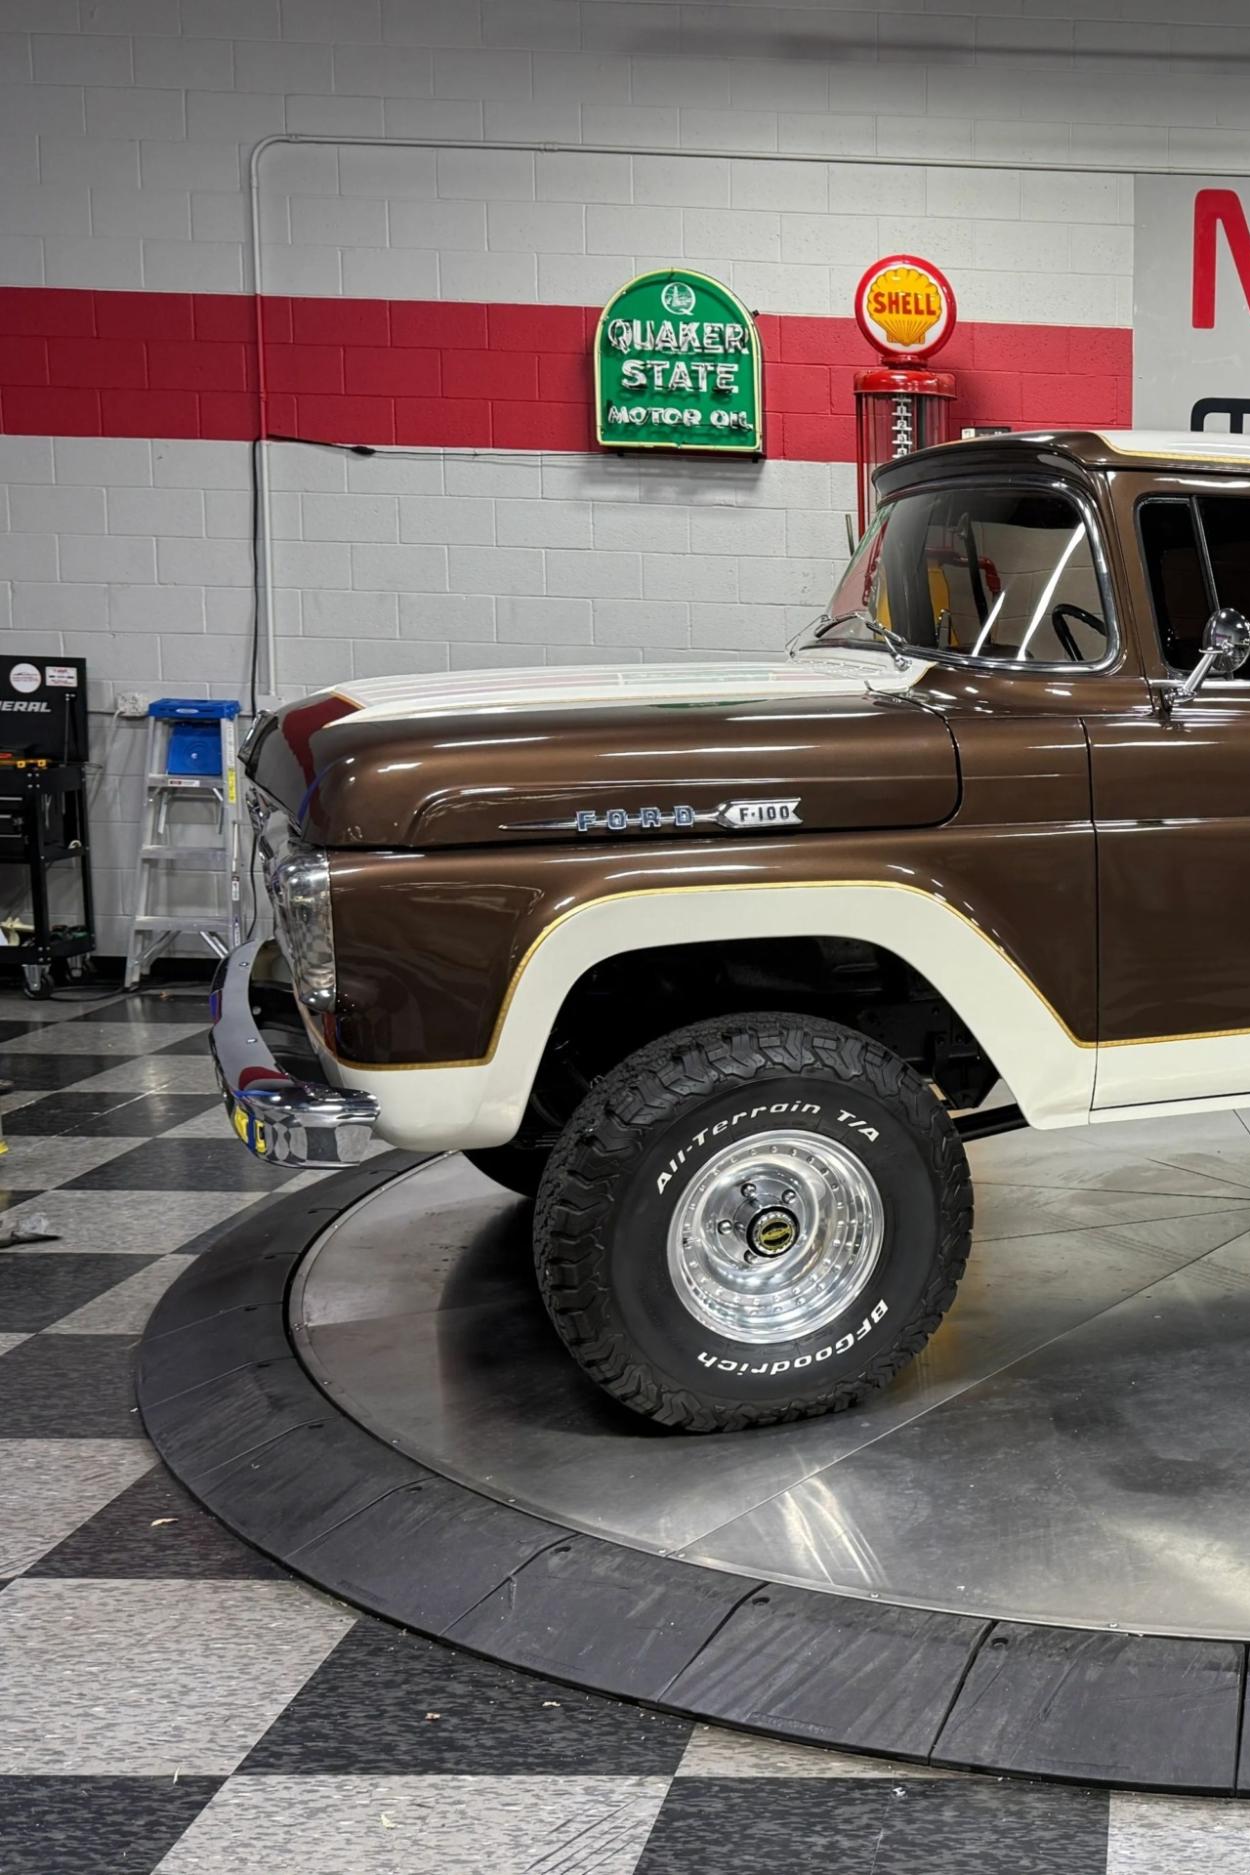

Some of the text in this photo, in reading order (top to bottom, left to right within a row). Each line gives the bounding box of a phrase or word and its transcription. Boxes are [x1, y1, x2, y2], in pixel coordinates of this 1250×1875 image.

[873, 291, 937, 316] SHELL
[608, 318, 750, 355] QUAKER
[621, 359, 739, 394] STATE
[608, 405, 753, 430] MOTOR OIL
[0, 701, 52, 713] ERAL
[576, 805, 696, 832] FORD
[656, 1100, 880, 1195] All-Terrain T/A
[698, 1299, 889, 1376] BFGoodrich
